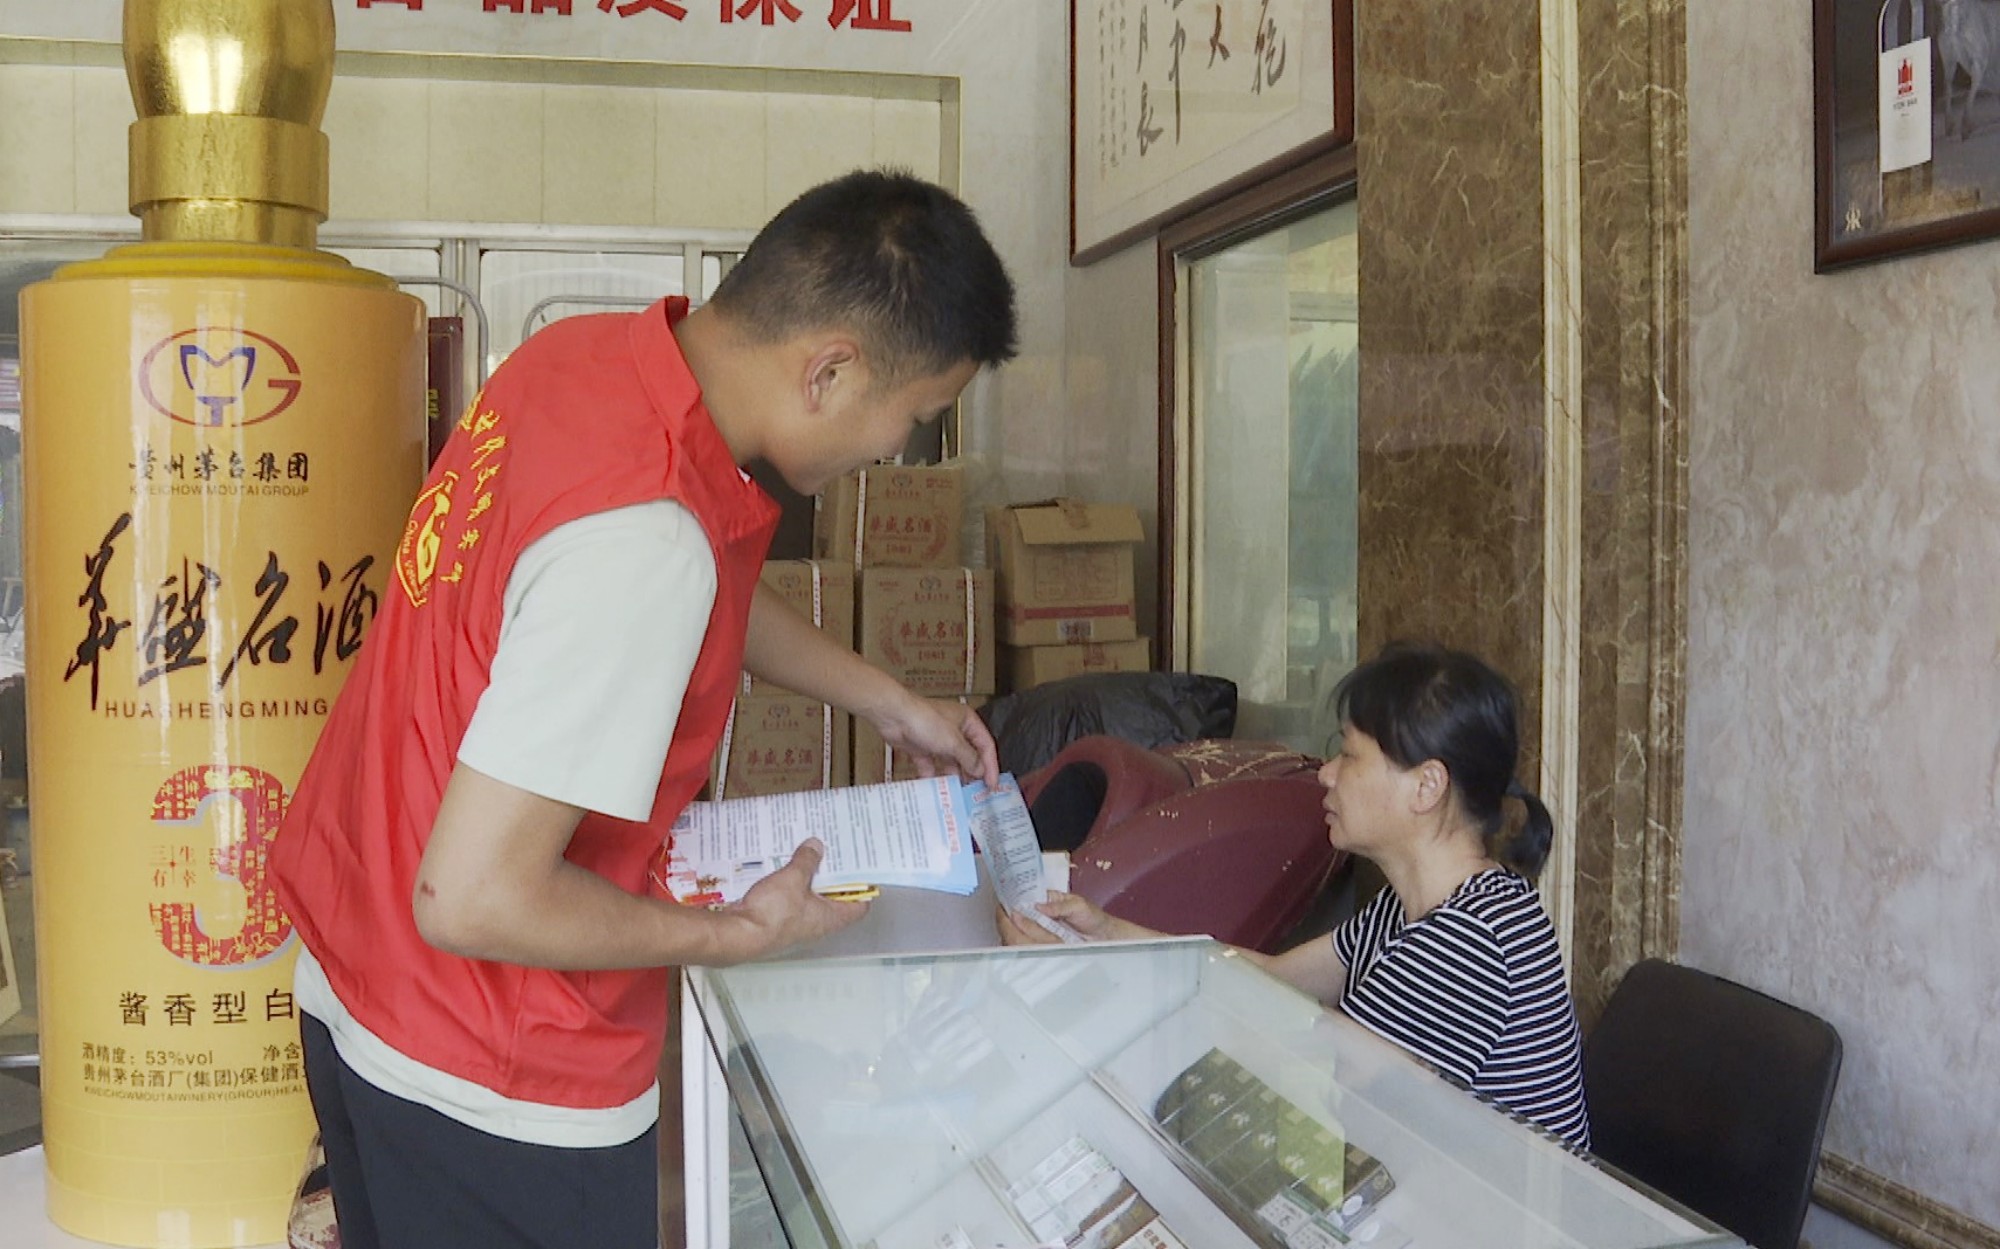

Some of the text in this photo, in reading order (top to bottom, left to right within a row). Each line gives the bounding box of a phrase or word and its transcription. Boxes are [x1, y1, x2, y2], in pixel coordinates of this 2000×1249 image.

[128, 443, 309, 482] 贵州茅台集团
[129, 485, 310, 496] KEICHOW MOUTAI GROUP
[119, 988, 293, 1027] 酱香型白
[84, 1062, 305, 1090] 贵州茅台酒厂(集团)保健酒
